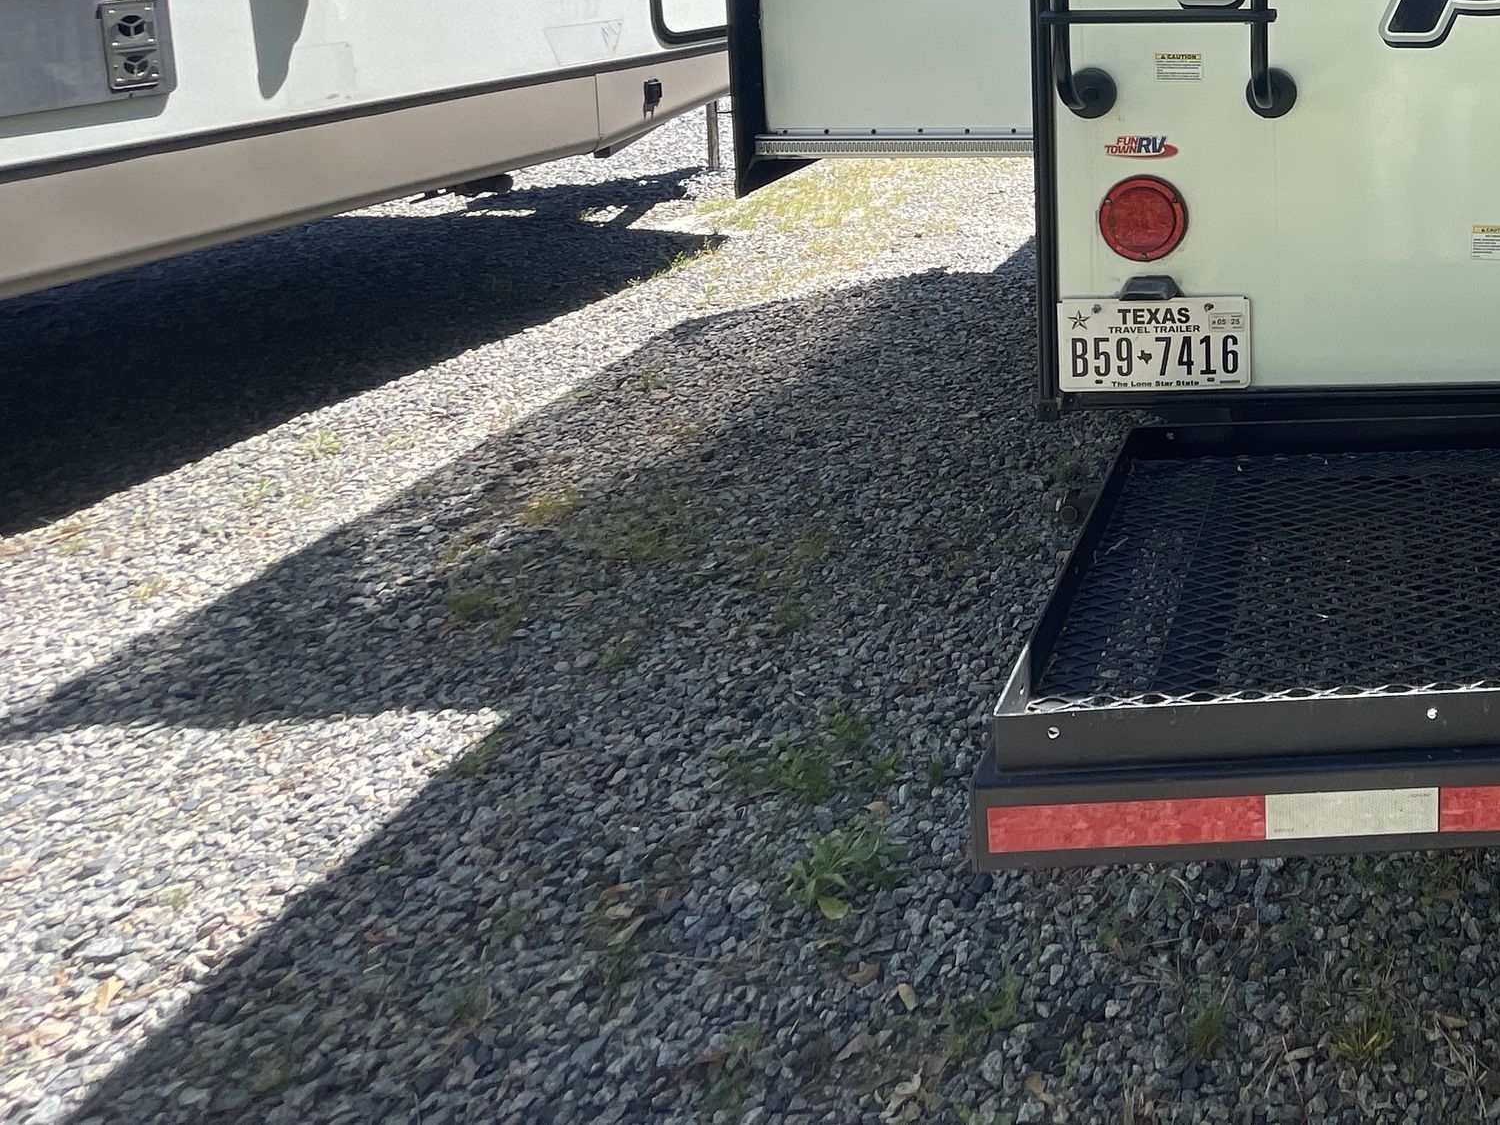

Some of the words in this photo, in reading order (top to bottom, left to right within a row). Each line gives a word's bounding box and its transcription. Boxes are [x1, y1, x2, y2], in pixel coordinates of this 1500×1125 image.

[1104, 145, 1138, 154] TOWN
[1116, 136, 1139, 146] FUN
[1136, 136, 1167, 154] RV
[1117, 307, 1191, 325] TEXAS
[1108, 326, 1150, 334] TRAVEL
[1153, 325, 1200, 333] TRAILER
[1071, 337, 1133, 378] B59
[1154, 334, 1239, 376] 7416
[1111, 380, 1128, 388] The
